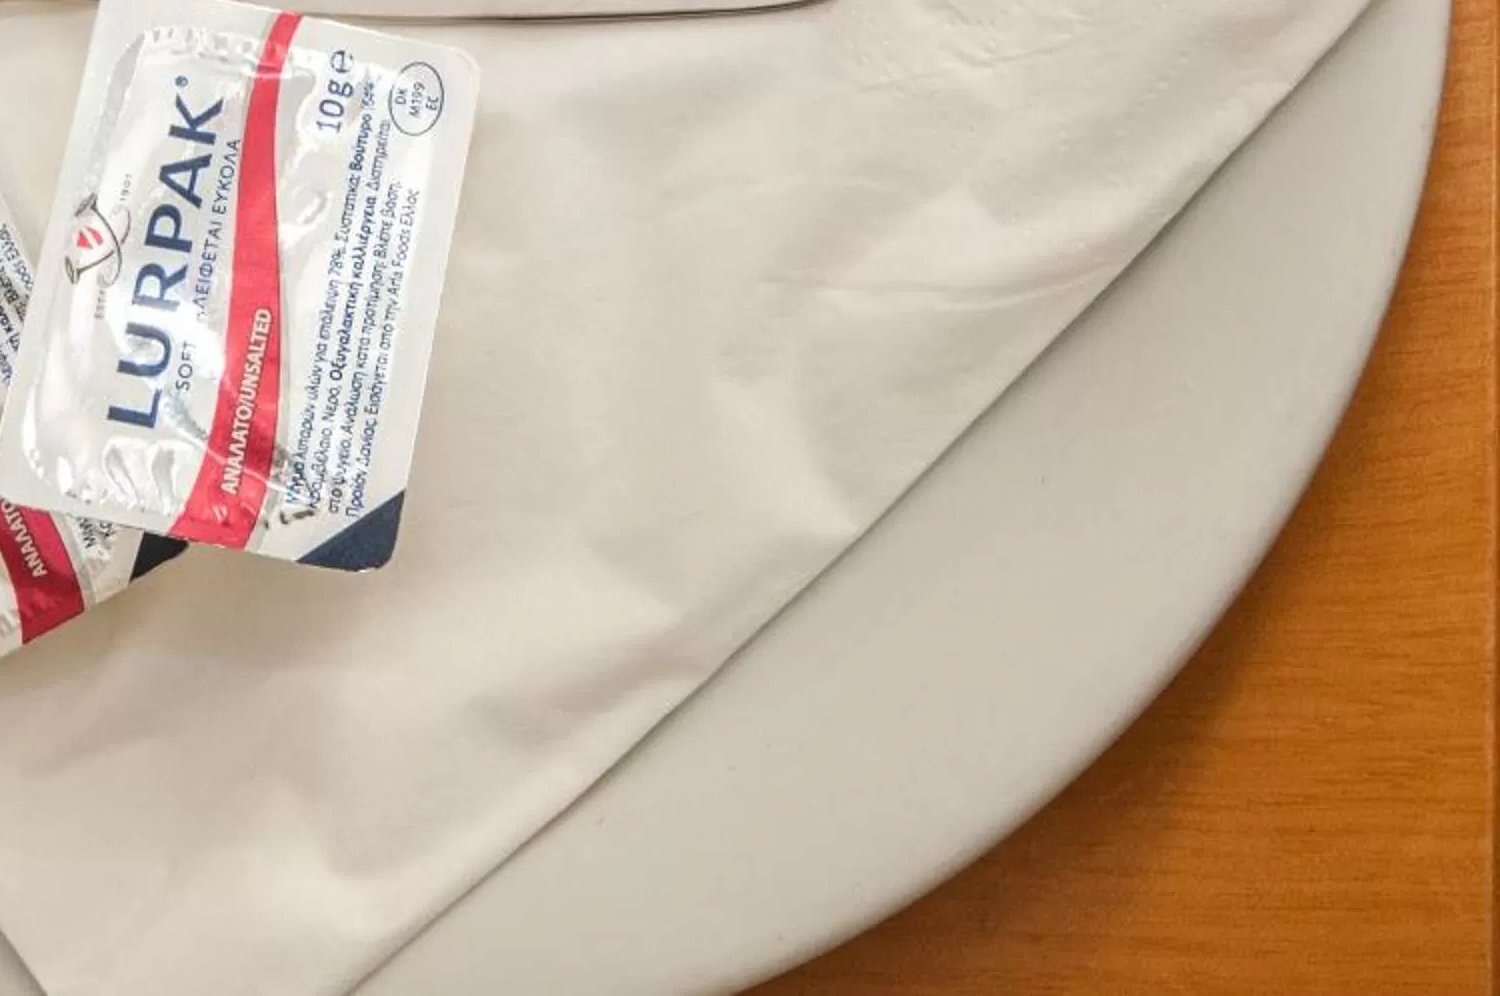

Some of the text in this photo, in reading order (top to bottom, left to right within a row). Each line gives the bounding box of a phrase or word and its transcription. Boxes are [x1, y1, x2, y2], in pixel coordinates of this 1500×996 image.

[174, 137, 239, 391] SOFT ΛΕΙΦΕΤΑΙ ΕΥΚΟΛΑ
